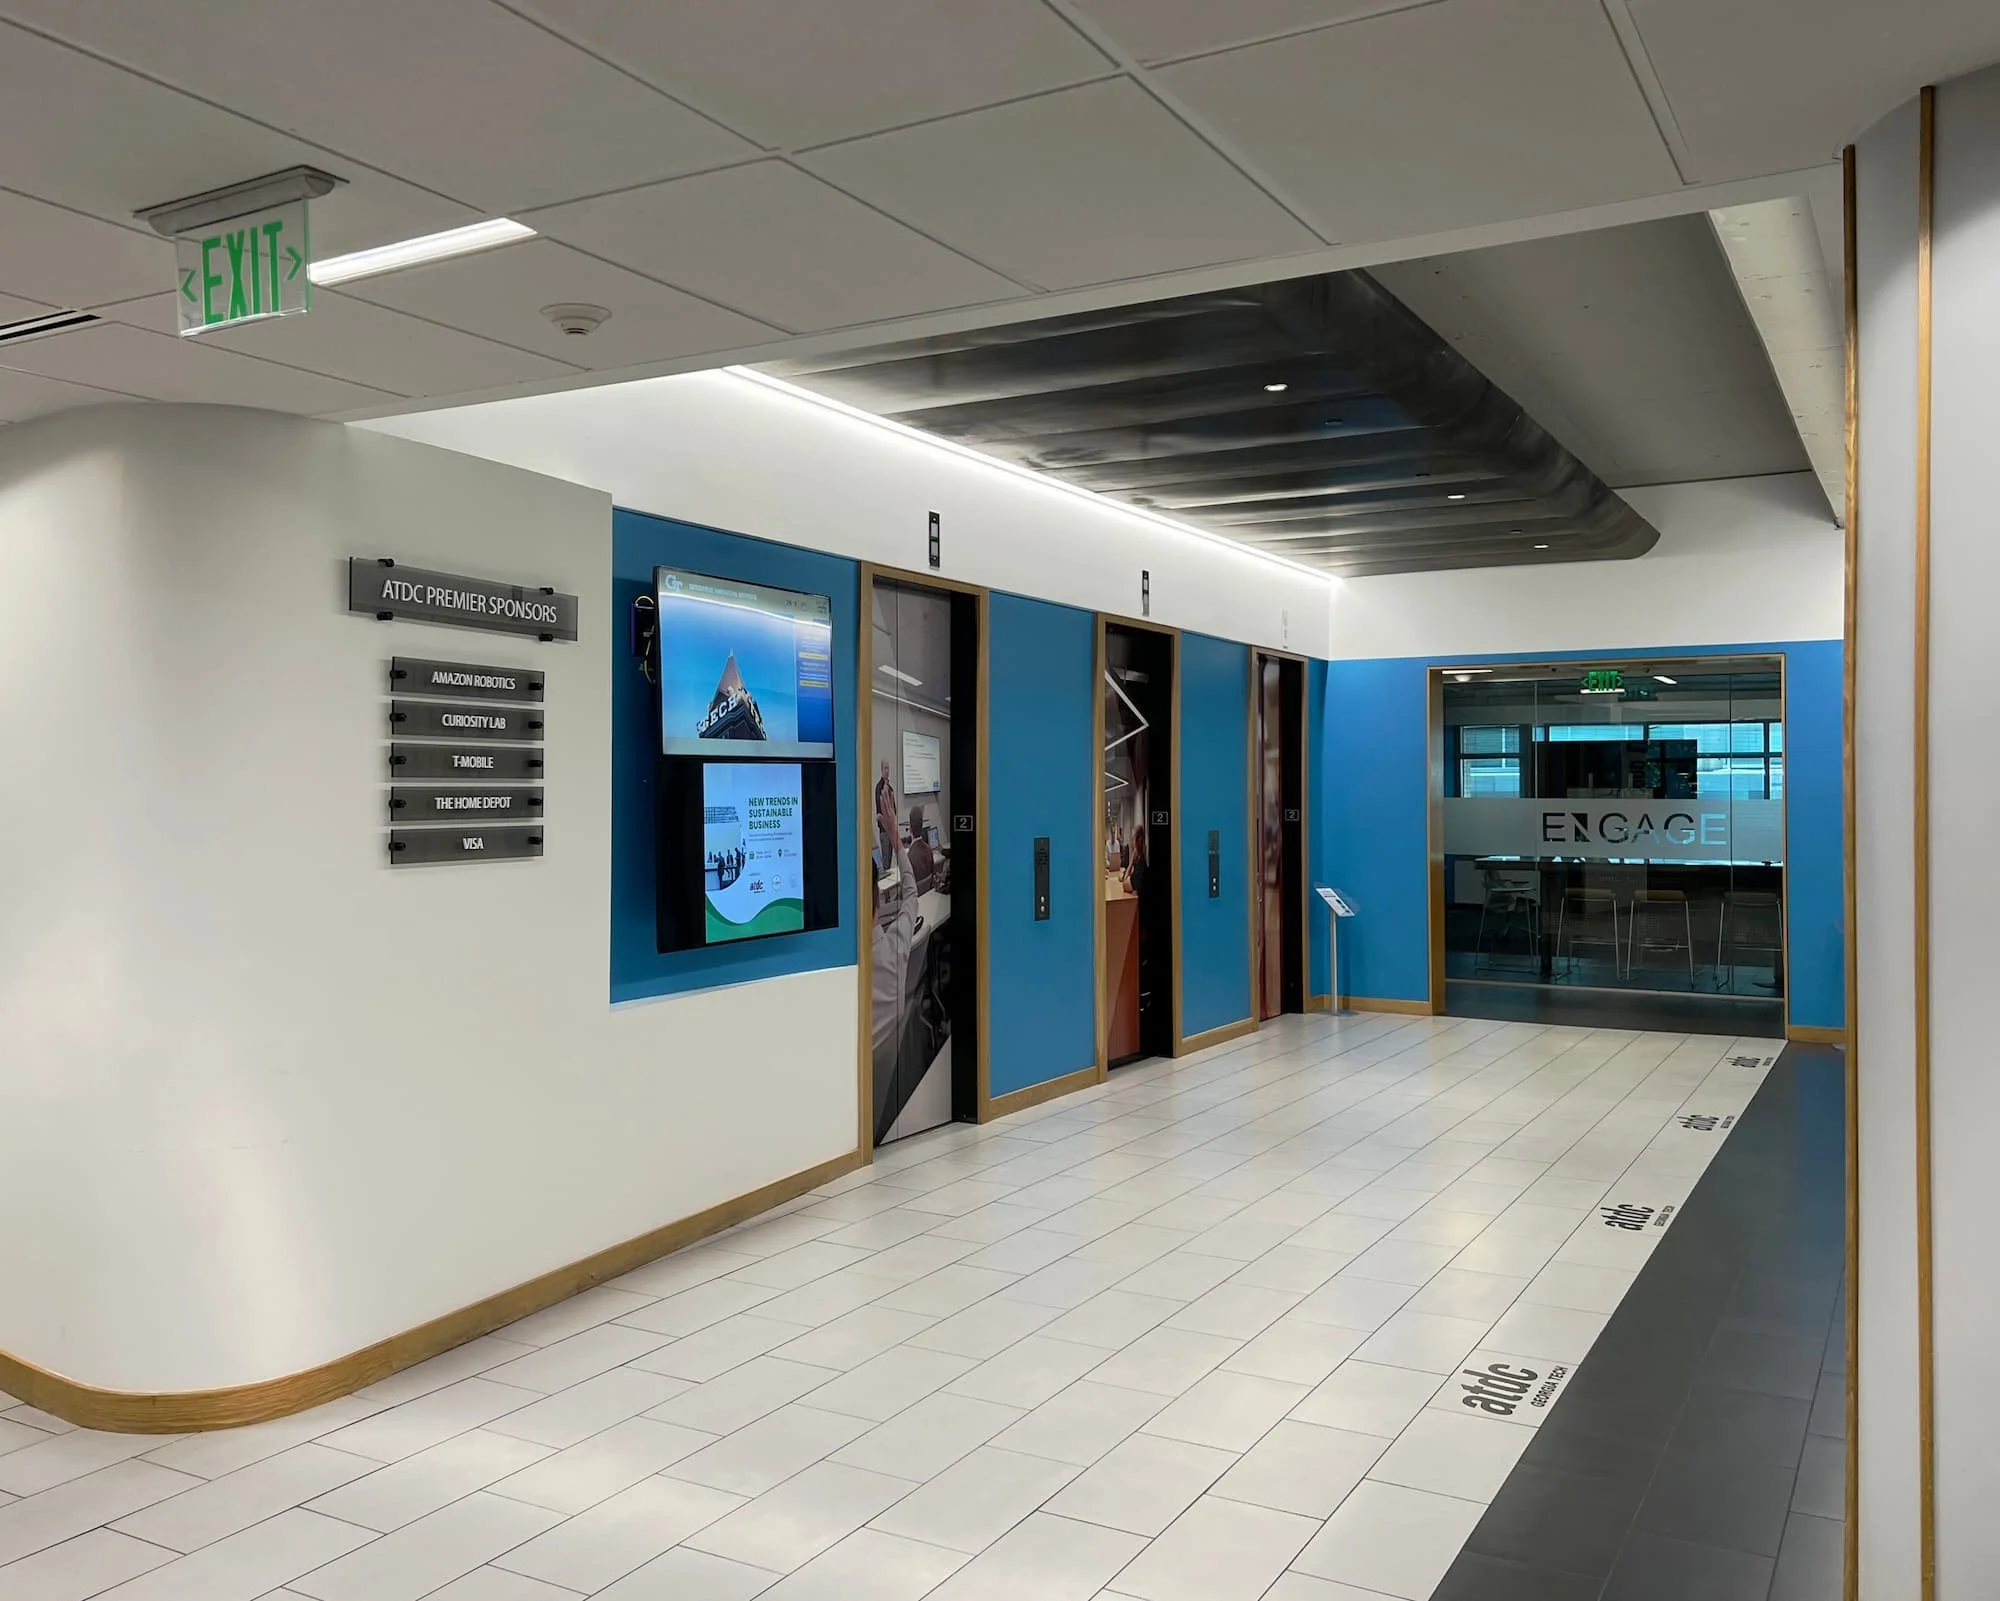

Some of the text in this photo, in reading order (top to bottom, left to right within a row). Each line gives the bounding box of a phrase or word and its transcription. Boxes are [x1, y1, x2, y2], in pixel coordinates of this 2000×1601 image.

[202, 220, 283, 325] EXIT
[382, 579, 557, 623] ATDC PREMIER SPONSORS
[432, 671, 516, 690] AMAZON ROBOTICS
[1589, 671, 1618, 691] EXIT
[442, 713, 506, 729] CURIOSITY LAB
[452, 755, 494, 769] T-MOBILE
[434, 796, 512, 810] THE HOME DEPOT
[748, 796, 799, 807] NEW TRENDS IN
[748, 807, 793, 818] SUSTAINABLE
[1156, 813, 1164, 823] 2
[748, 819, 781, 830] BUSINESS
[959, 817, 968, 829] 2
[1542, 812, 1728, 846] ENGAGE
[462, 837, 484, 850] VISA
[1600, 1204, 1655, 1231] atdc
[1460, 1363, 1538, 1415] atdc
[1530, 1381, 1559, 1408] GEORGIA
